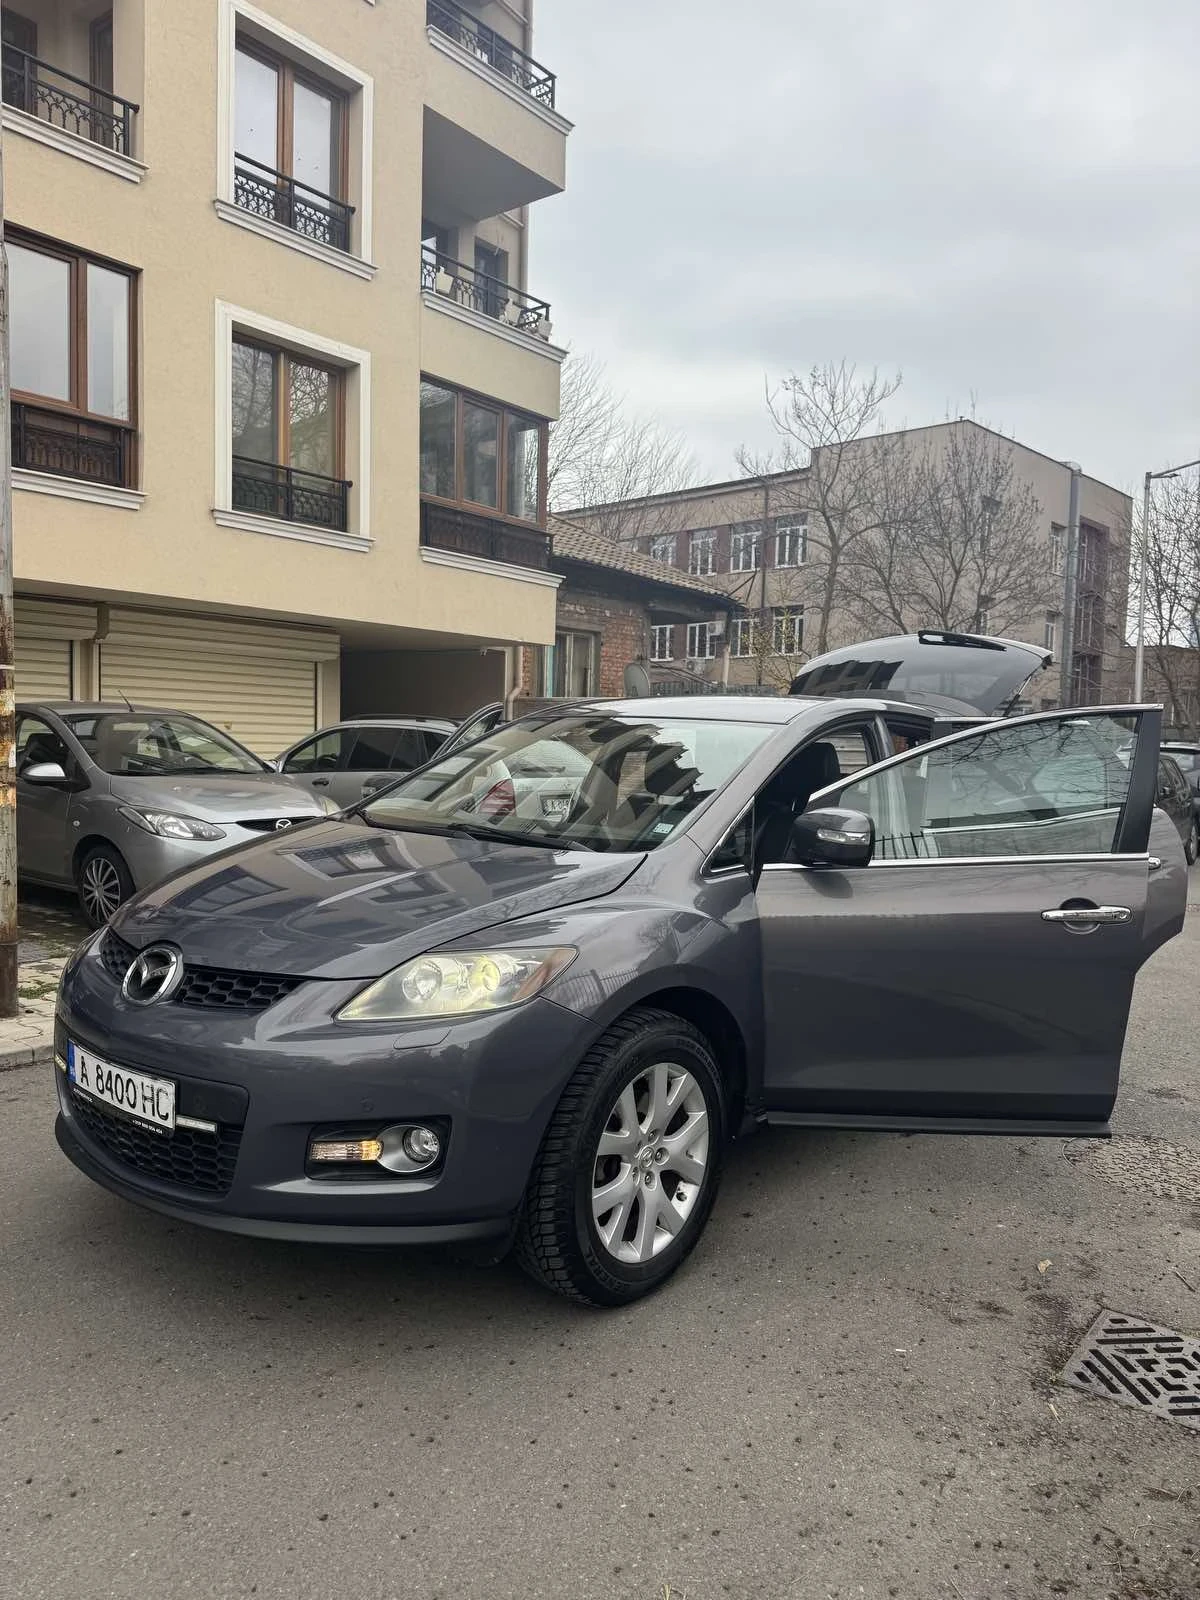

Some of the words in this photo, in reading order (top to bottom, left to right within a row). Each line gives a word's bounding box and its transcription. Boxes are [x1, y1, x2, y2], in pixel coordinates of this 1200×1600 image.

[80, 1055, 89, 1087] A
[95, 1064, 137, 1109] 8400
[141, 1081, 169, 1121] HC
